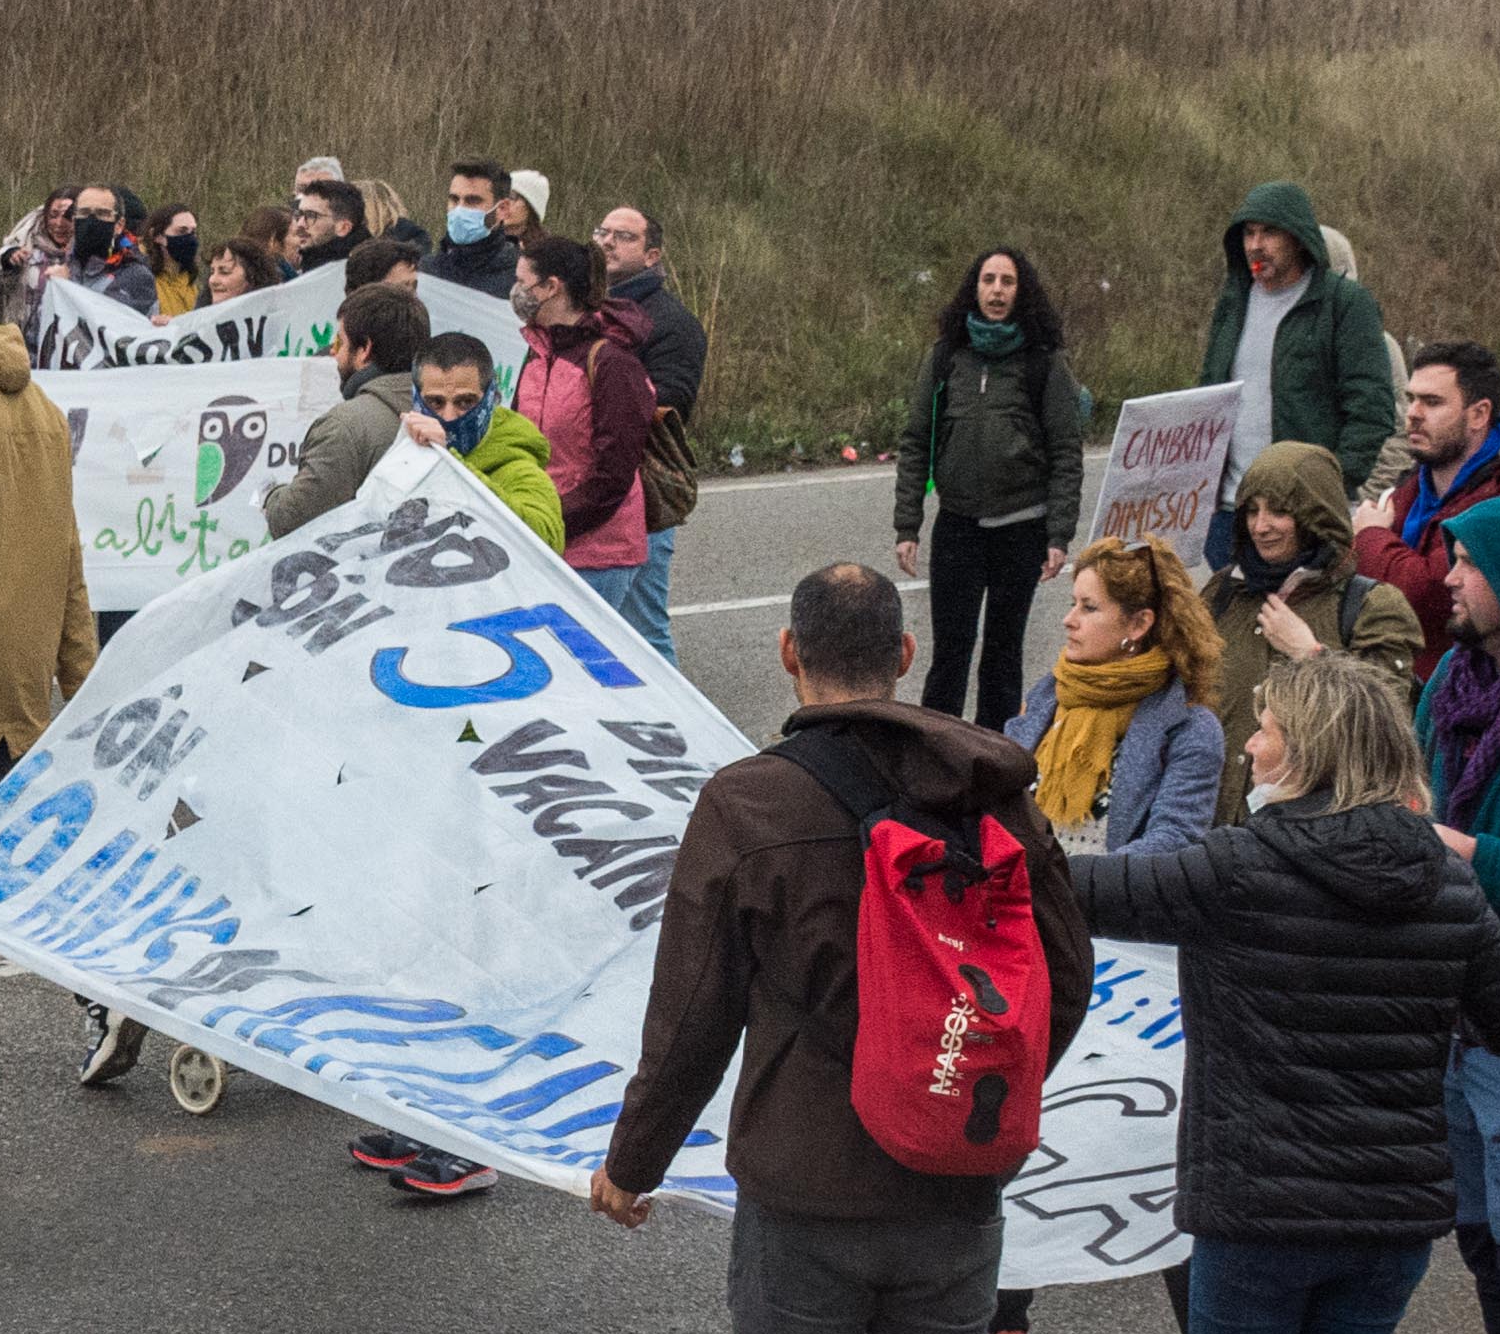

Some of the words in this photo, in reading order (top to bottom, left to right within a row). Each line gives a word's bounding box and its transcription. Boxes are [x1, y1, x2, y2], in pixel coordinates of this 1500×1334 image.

[1123, 418, 1227, 470] CAMBRAY
[1103, 478, 1208, 539] DIMISSIÓ
[370, 603, 646, 709] 5
